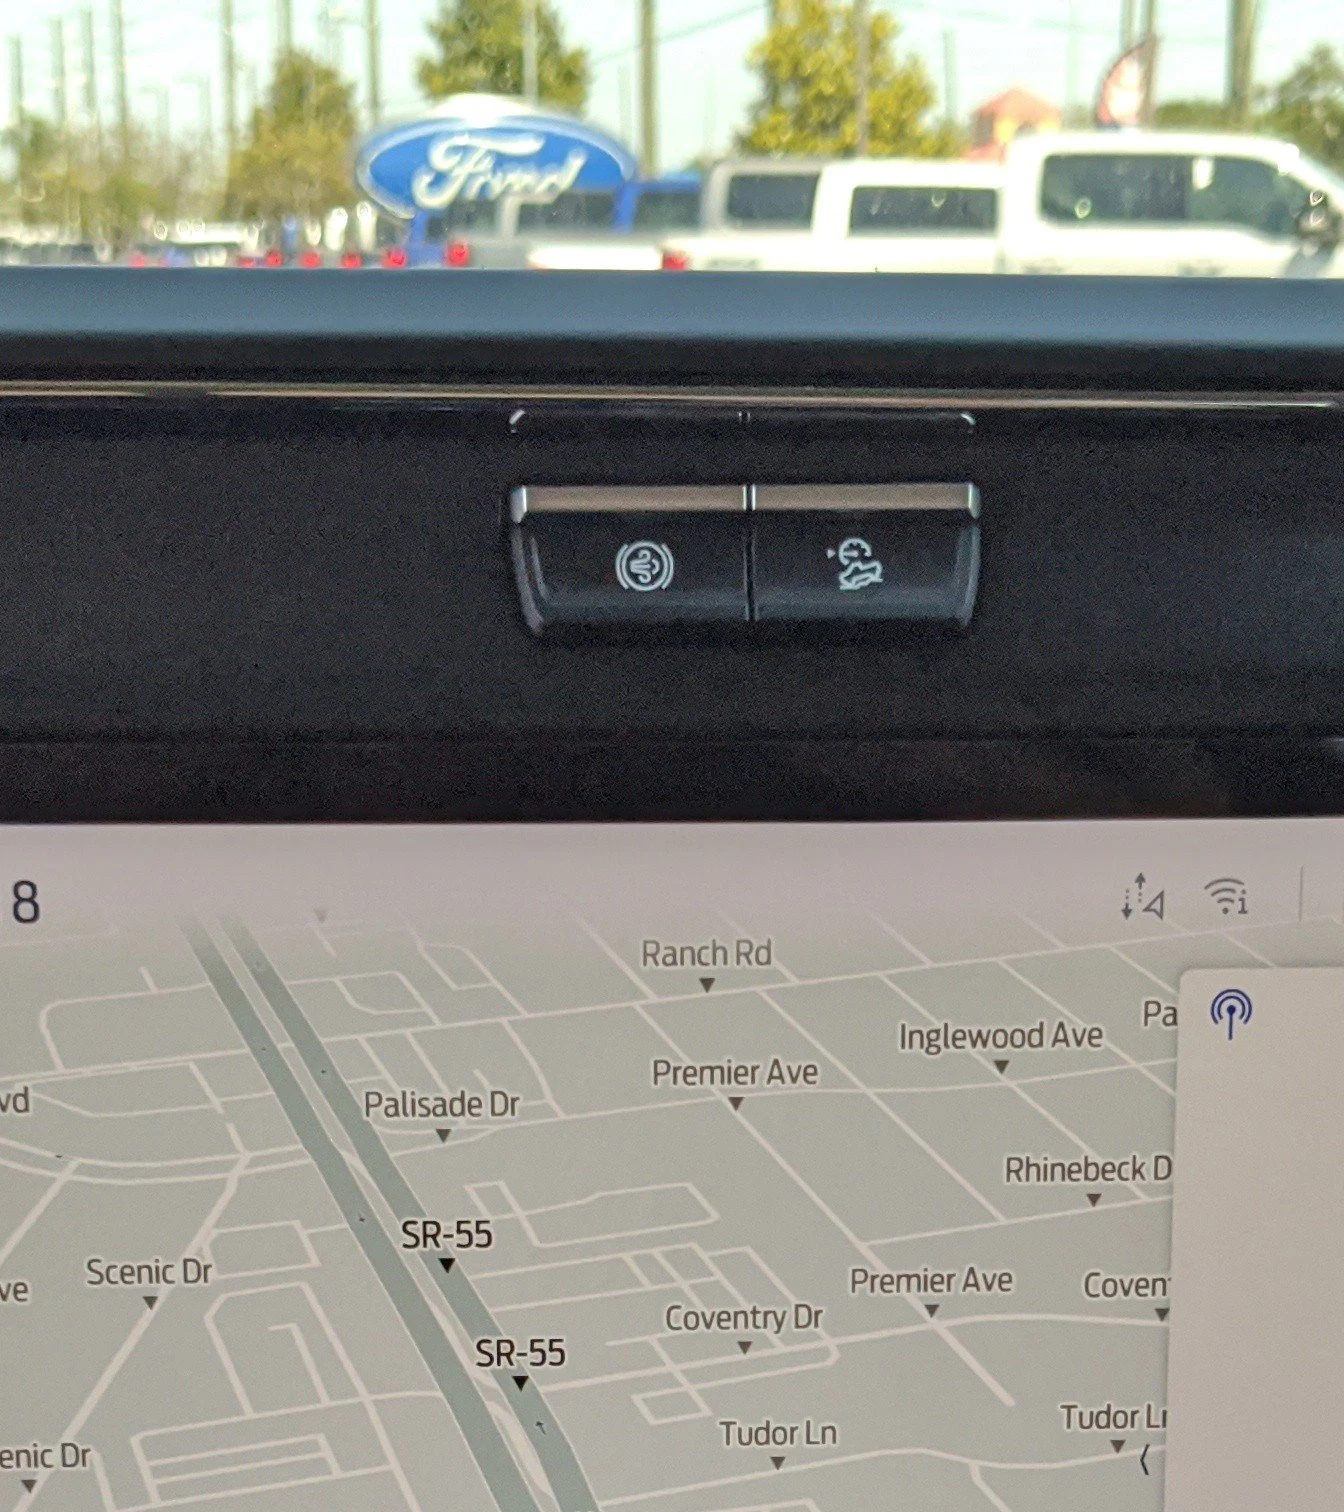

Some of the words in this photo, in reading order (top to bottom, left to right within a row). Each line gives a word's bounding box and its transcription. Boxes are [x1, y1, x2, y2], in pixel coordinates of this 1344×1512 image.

[412, 133, 588, 210] Ford
[642, 939, 728, 967] Ranch
[735, 939, 773, 967] Rd
[1144, 1001, 1177, 1028] Pa
[899, 1022, 1045, 1056] Inglewood
[1051, 1024, 1104, 1050] Ave
[653, 1060, 760, 1087] Premier
[766, 1060, 819, 1087] Ave
[364, 1090, 483, 1119] Palisade
[489, 1091, 520, 1118] Dr
[1006, 1155, 1147, 1183] Rhinebeck
[401, 1220, 494, 1249] SR-55
[86, 1258, 177, 1286] Scenic
[183, 1259, 213, 1285] Dr
[851, 1266, 957, 1294] Premier
[962, 1267, 1014, 1293] Ave
[1083, 1272, 1172, 1299] Coven
[665, 1305, 787, 1336] Coventry
[794, 1305, 825, 1331] Dr
[475, 1339, 566, 1367] SR-55
[1060, 1403, 1139, 1431] Tudor
[719, 1419, 798, 1447] Tudor
[805, 1420, 838, 1446] Ln
[61, 1444, 91, 1470] Dr
